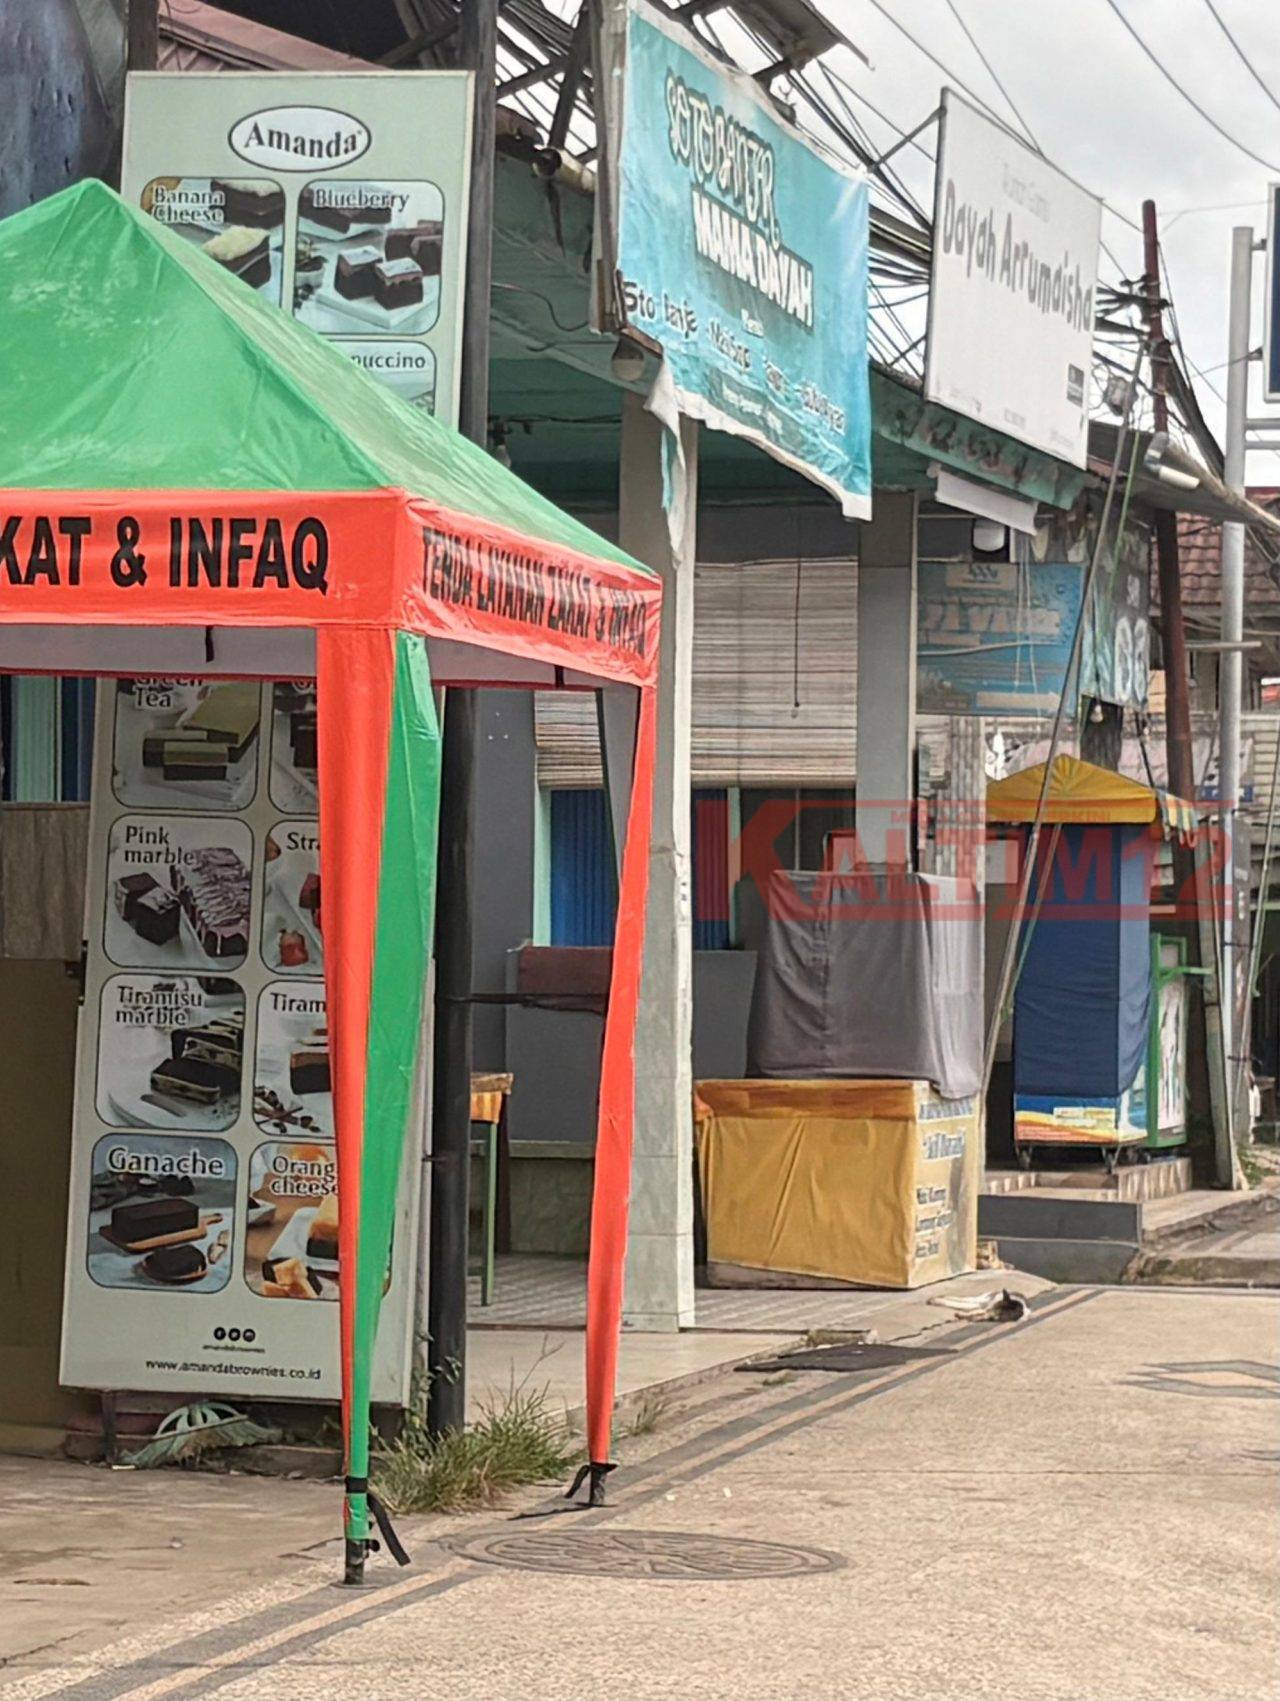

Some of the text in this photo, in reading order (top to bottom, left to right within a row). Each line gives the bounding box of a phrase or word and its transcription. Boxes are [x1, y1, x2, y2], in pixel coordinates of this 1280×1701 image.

[243, 121, 358, 159] Amanda
[154, 187, 224, 204] Banana
[314, 188, 410, 212] Blueberry
[153, 204, 224, 223] Cheese
[943, 177, 997, 282] Dayah
[999, 211, 1093, 333] Arrumaisha
[110, 515, 147, 588] &
[169, 516, 329, 596] INFAQ
[422, 526, 473, 608] TENDA
[476, 542, 544, 627] LAYANAN
[137, 687, 171, 708] Tea
[125, 826, 169, 845] Pink
[124, 850, 195, 866] marble
[117, 984, 203, 1008] Tiramisu
[116, 1006, 188, 1026] marble
[108, 1148, 224, 1177] Ganache
